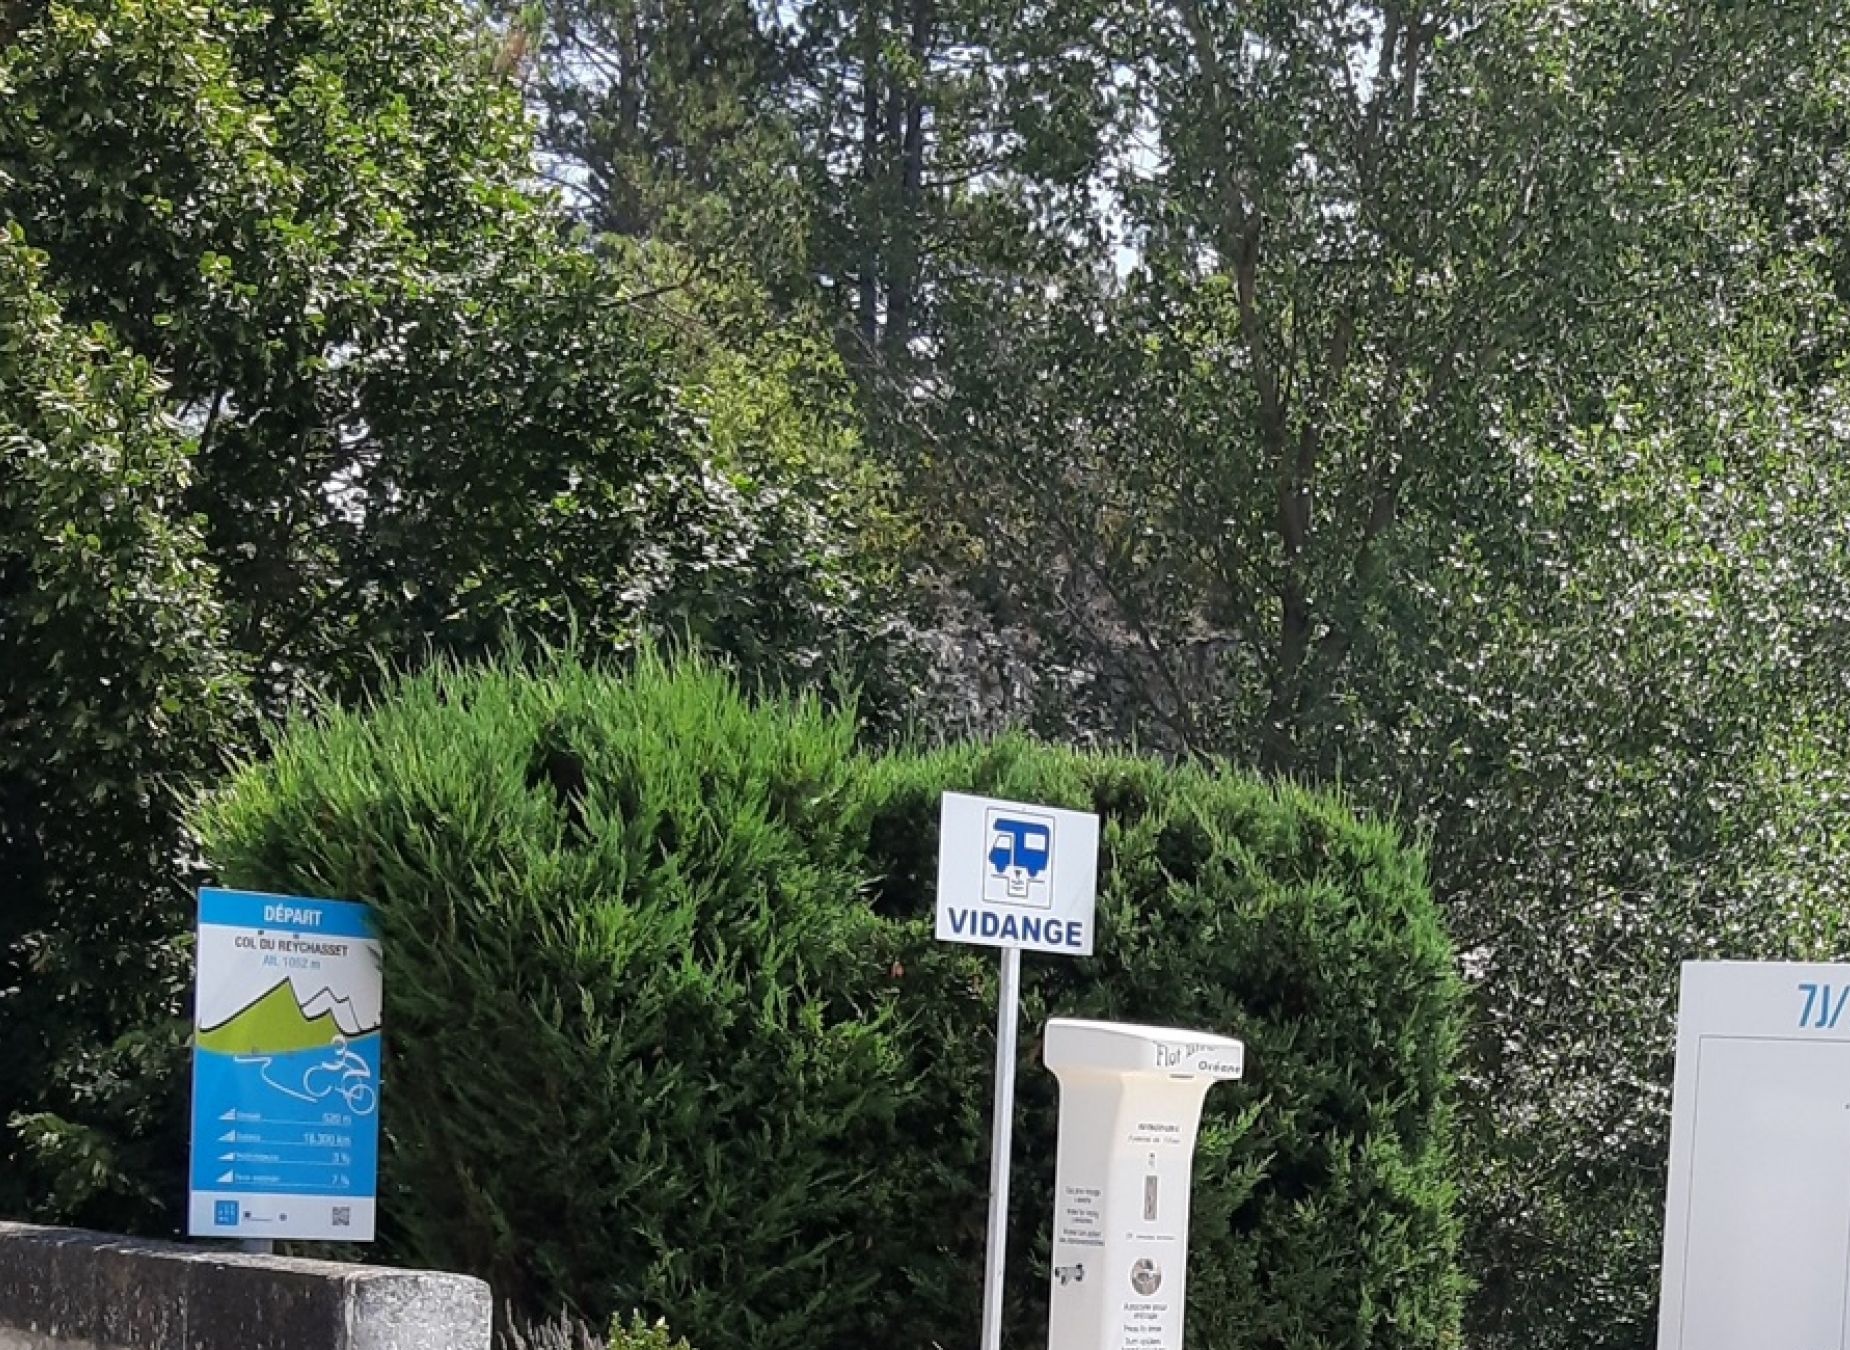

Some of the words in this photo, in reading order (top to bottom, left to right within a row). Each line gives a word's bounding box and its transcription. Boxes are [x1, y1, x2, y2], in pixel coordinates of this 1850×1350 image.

[263, 903, 323, 926] DÉPART
[947, 907, 1083, 946] VIDANGE
[234, 936, 257, 950] COL
[259, 938, 275, 950] DU
